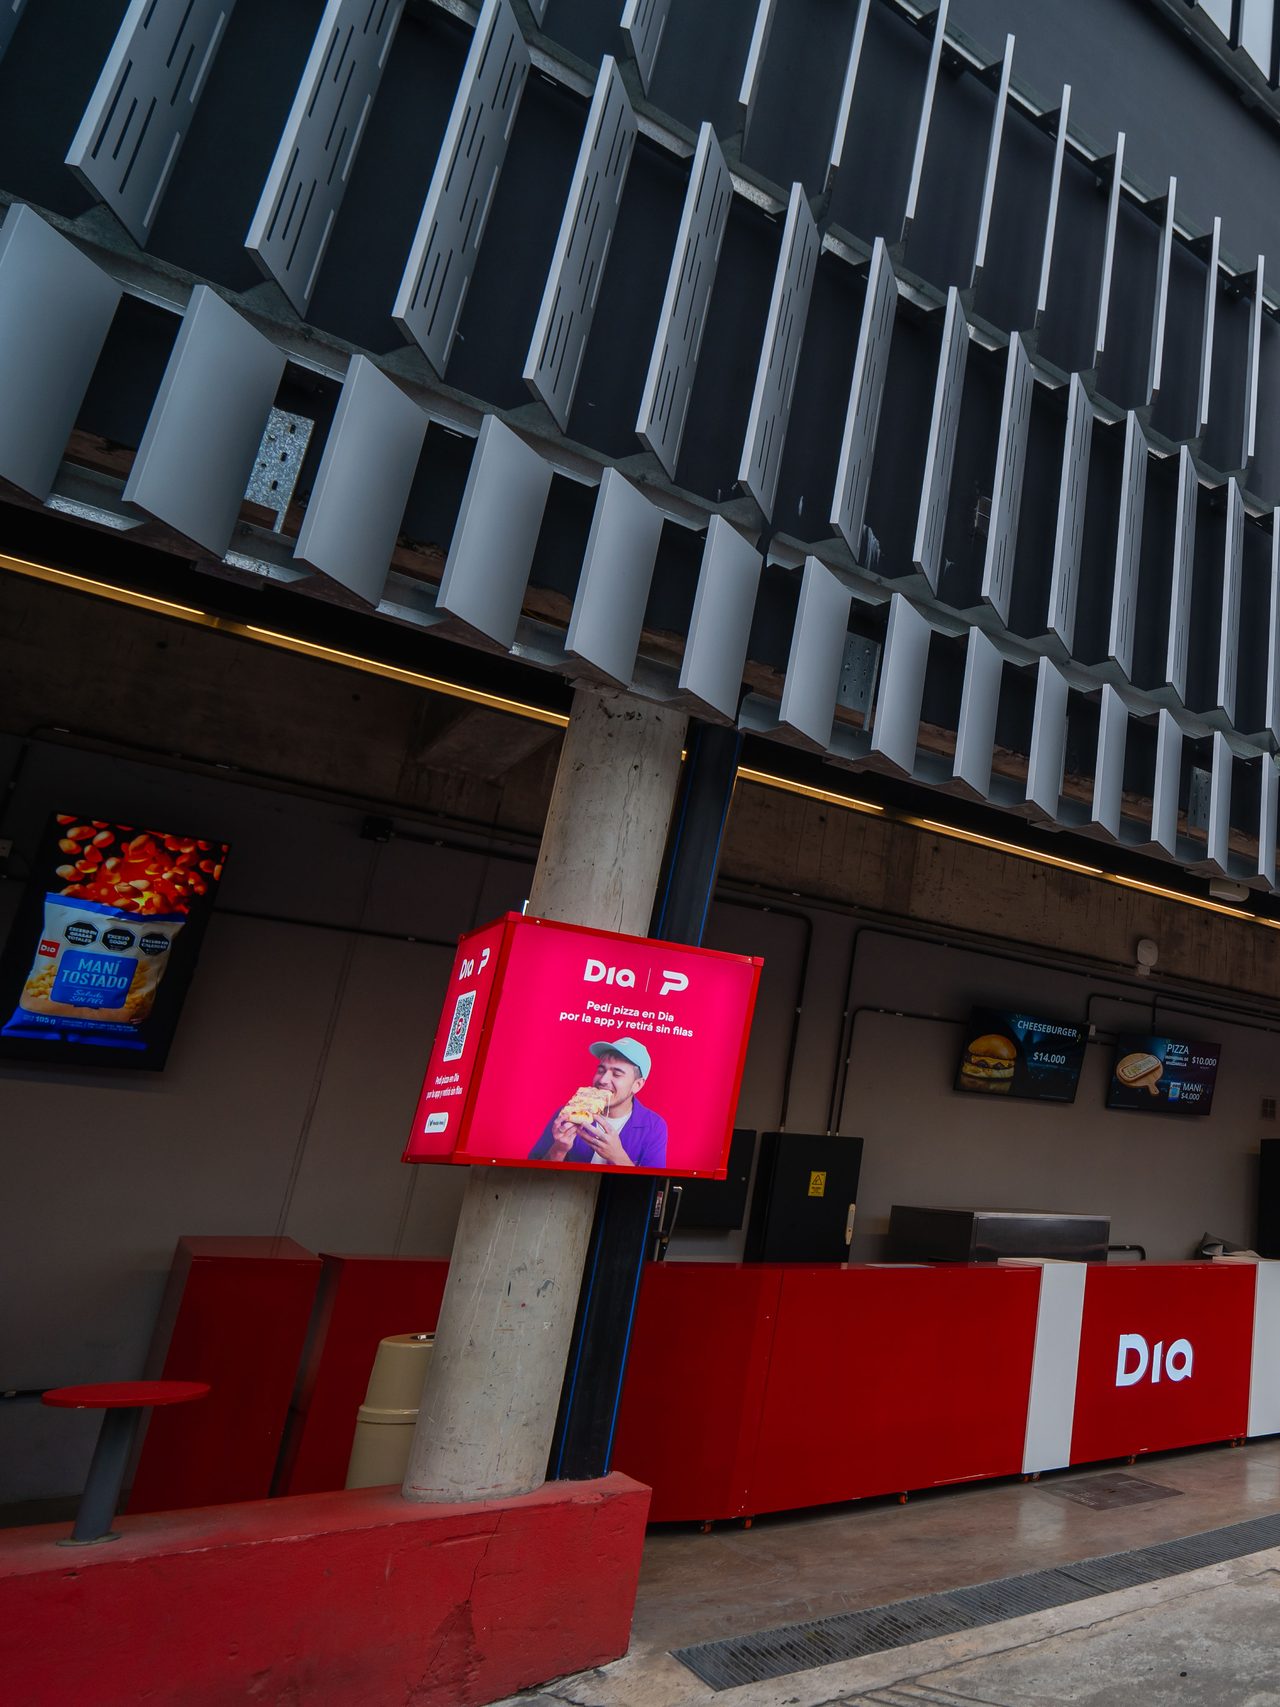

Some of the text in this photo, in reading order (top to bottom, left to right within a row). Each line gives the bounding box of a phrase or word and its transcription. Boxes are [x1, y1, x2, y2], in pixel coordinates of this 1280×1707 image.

[78, 958, 121, 976] MANÍ
[583, 958, 636, 988] Dia
[61, 969, 128, 990] TOSTADO
[586, 1000, 675, 1022] Pedí pizza en Dia
[559, 1011, 694, 1037] por la app y retirá sin filas
[1017, 1019, 1078, 1038] CHEESEBURGER
[1032, 1051, 1066, 1065] $14.000
[1166, 1043, 1190, 1055] PIZZA
[1191, 1056, 1217, 1066] $10.000
[1180, 1092, 1201, 1101] $4.000
